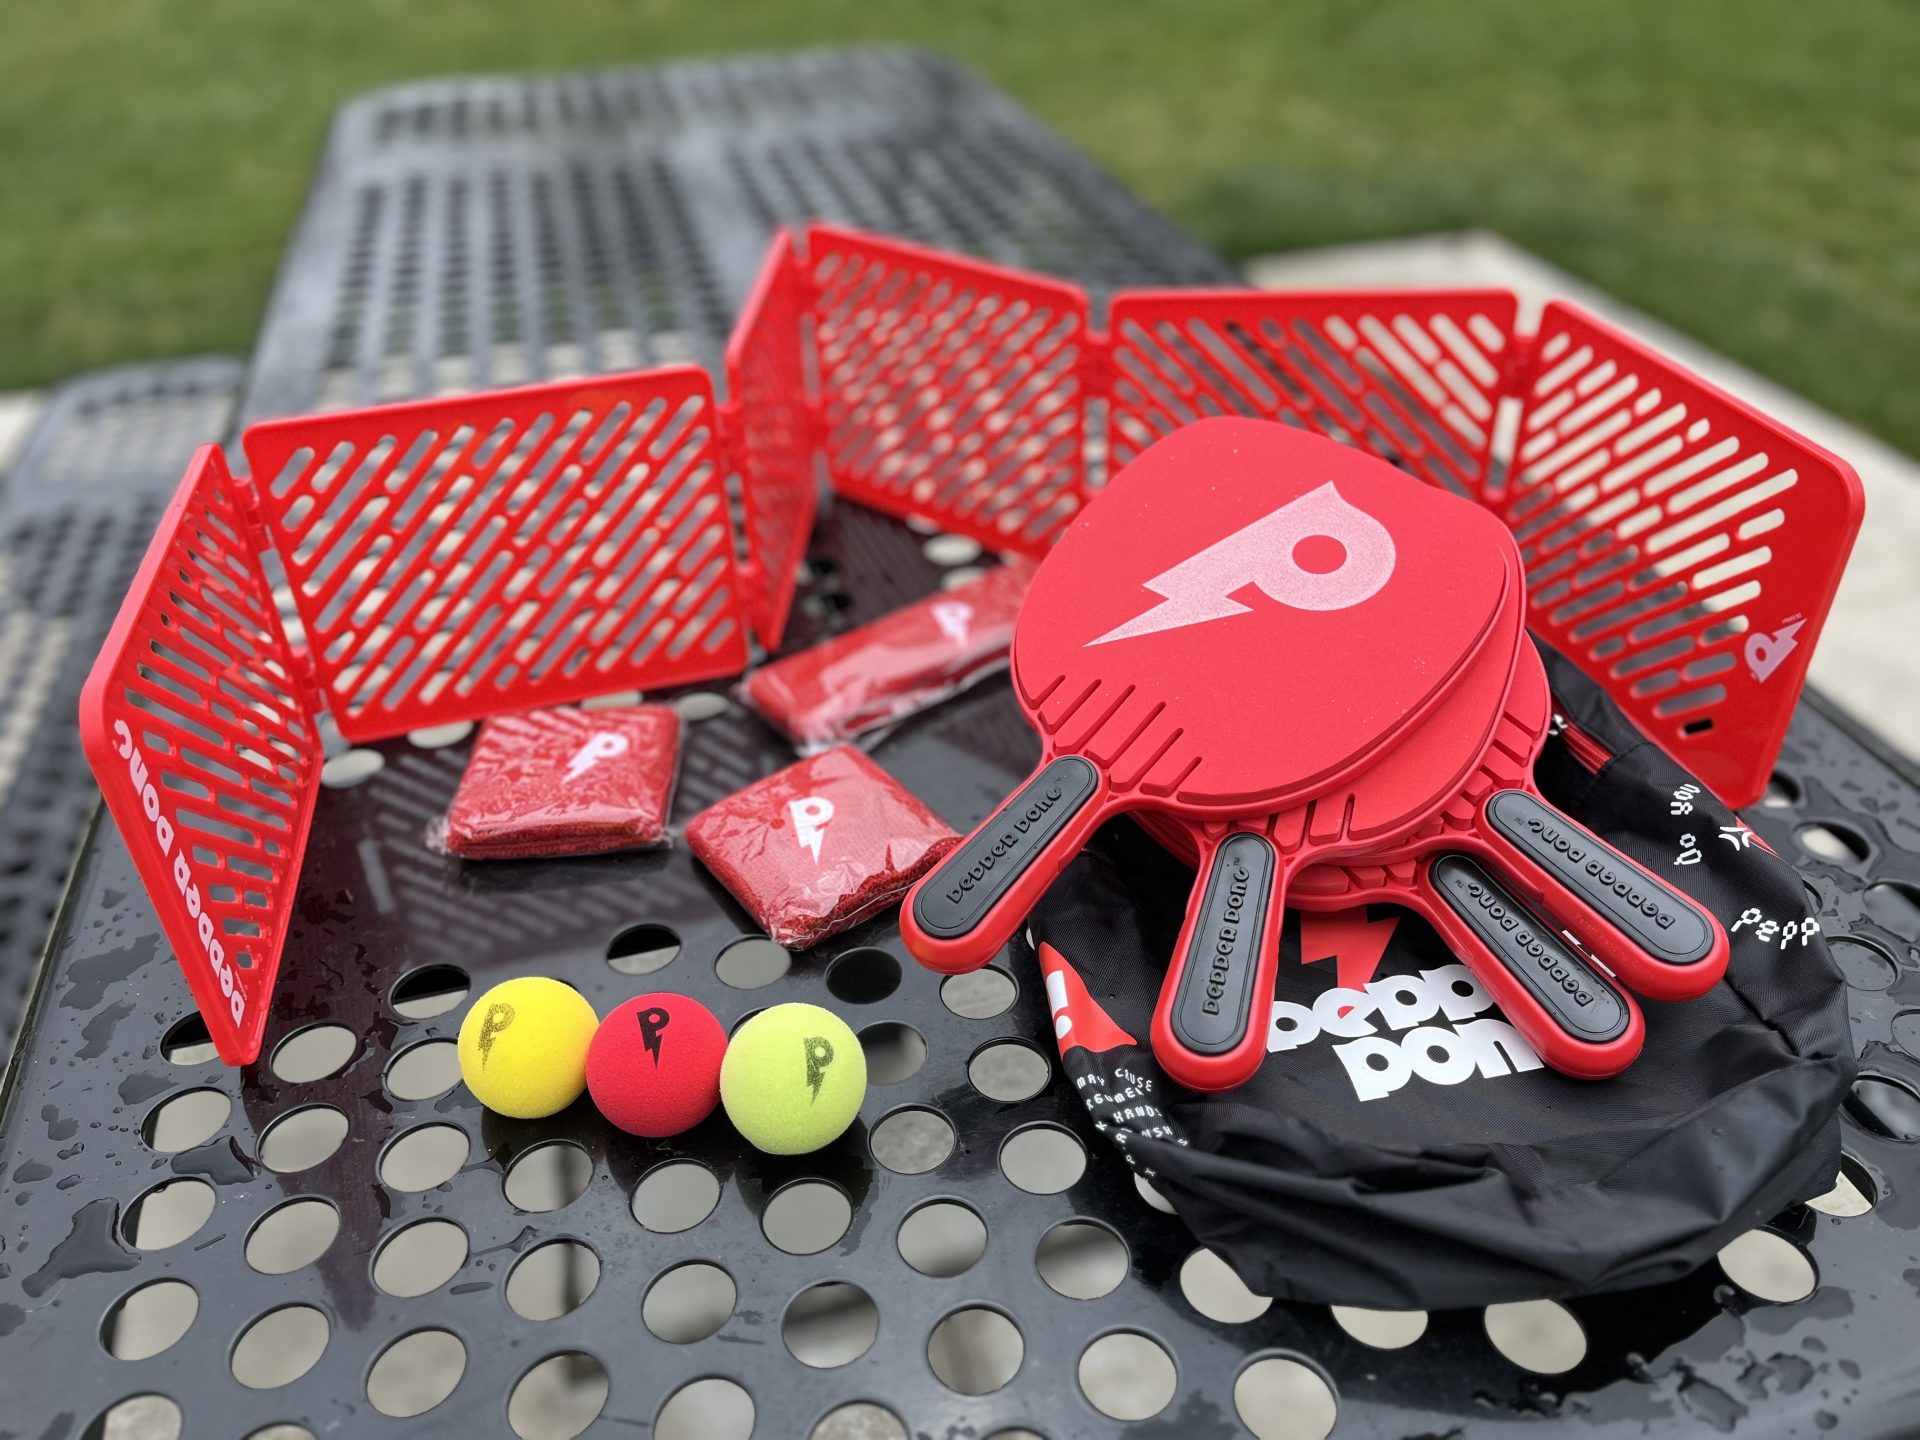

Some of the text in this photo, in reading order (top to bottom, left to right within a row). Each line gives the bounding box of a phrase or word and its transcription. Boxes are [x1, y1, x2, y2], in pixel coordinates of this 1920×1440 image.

[1076, 1068, 1153, 1092] MAY CAUSE
[1331, 1018, 1544, 1102] pon
